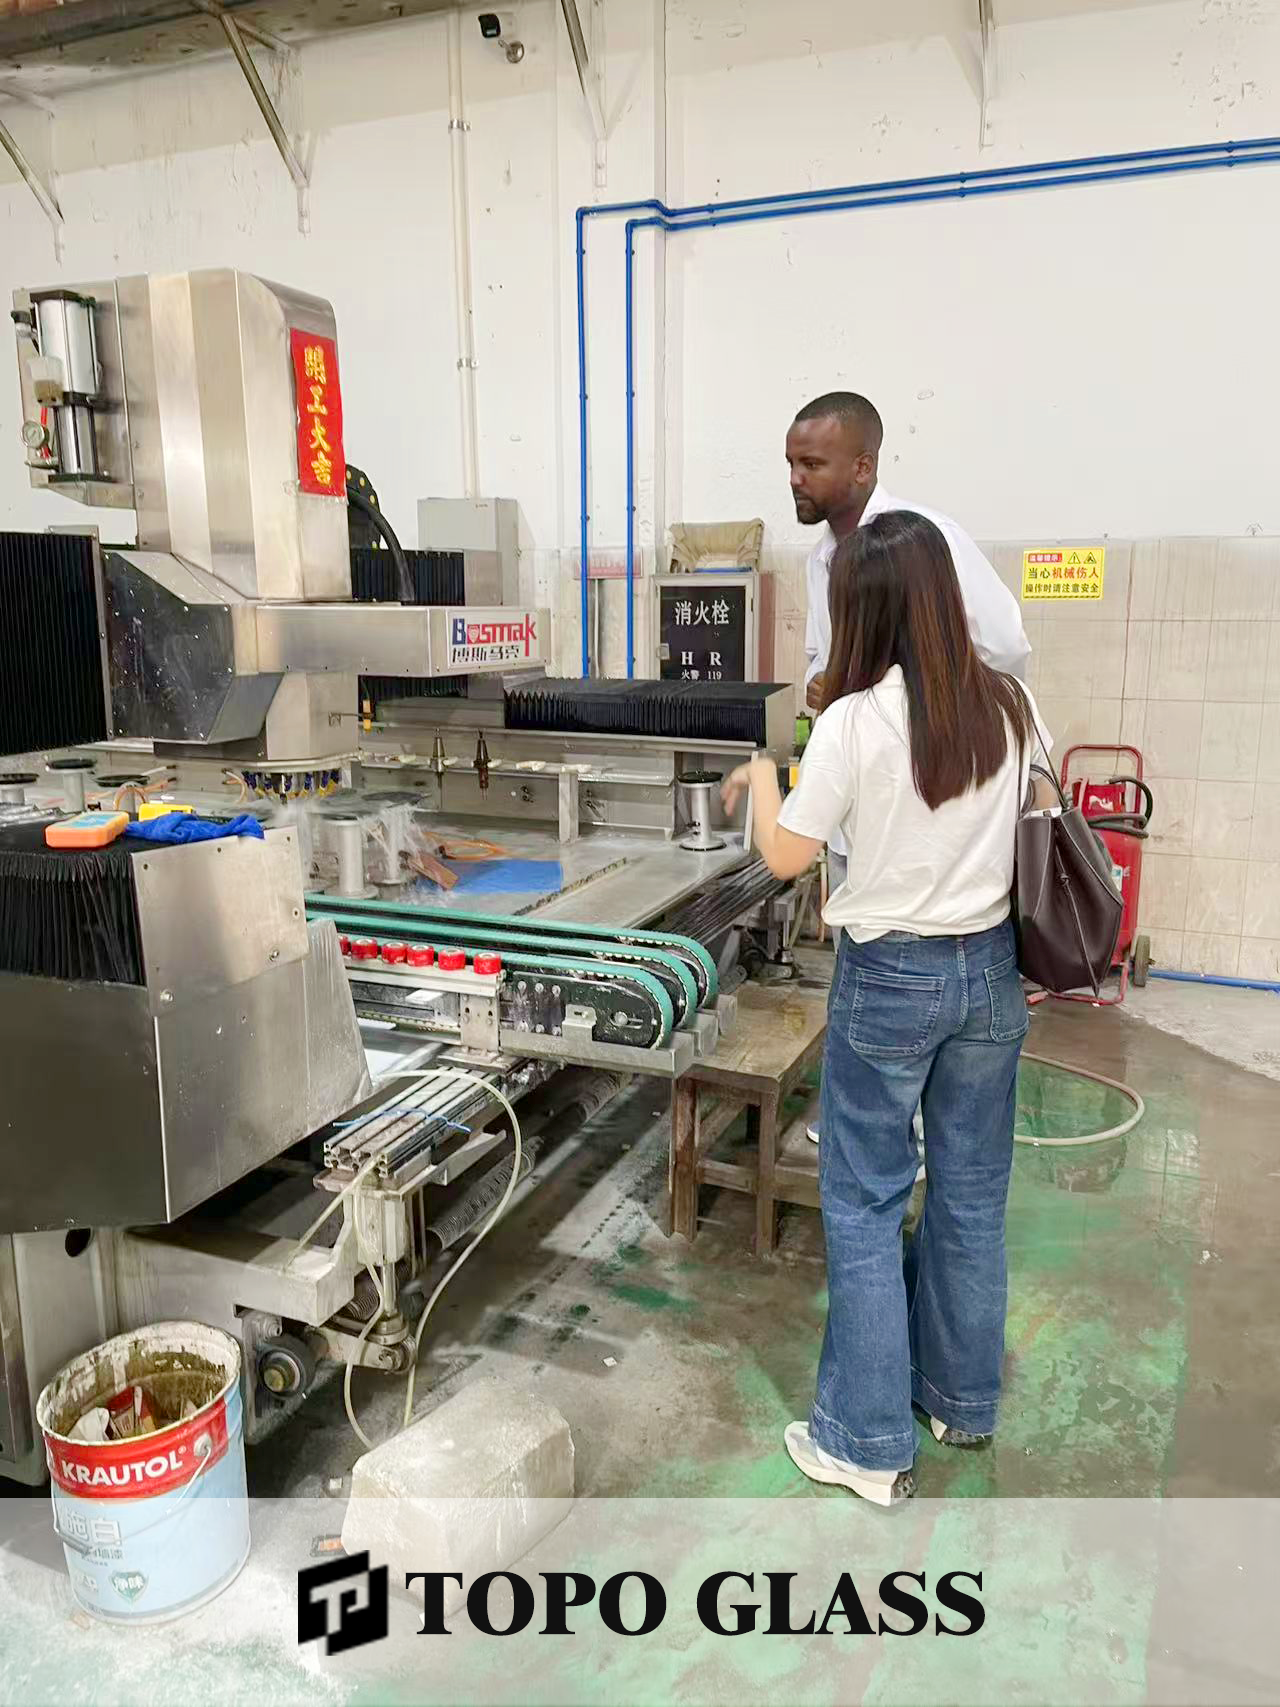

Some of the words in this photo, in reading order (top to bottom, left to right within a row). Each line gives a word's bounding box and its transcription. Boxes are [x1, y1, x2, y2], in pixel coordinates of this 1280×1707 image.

[1028, 567, 1099, 579] 当心机械伤人
[1025, 583, 1099, 593] 操作时请注意安全
[674, 600, 730, 626] 消火栓
[681, 651, 694, 666] H
[709, 651, 722, 666] R
[681, 669, 700, 681] 火警
[708, 670, 723, 680] 119
